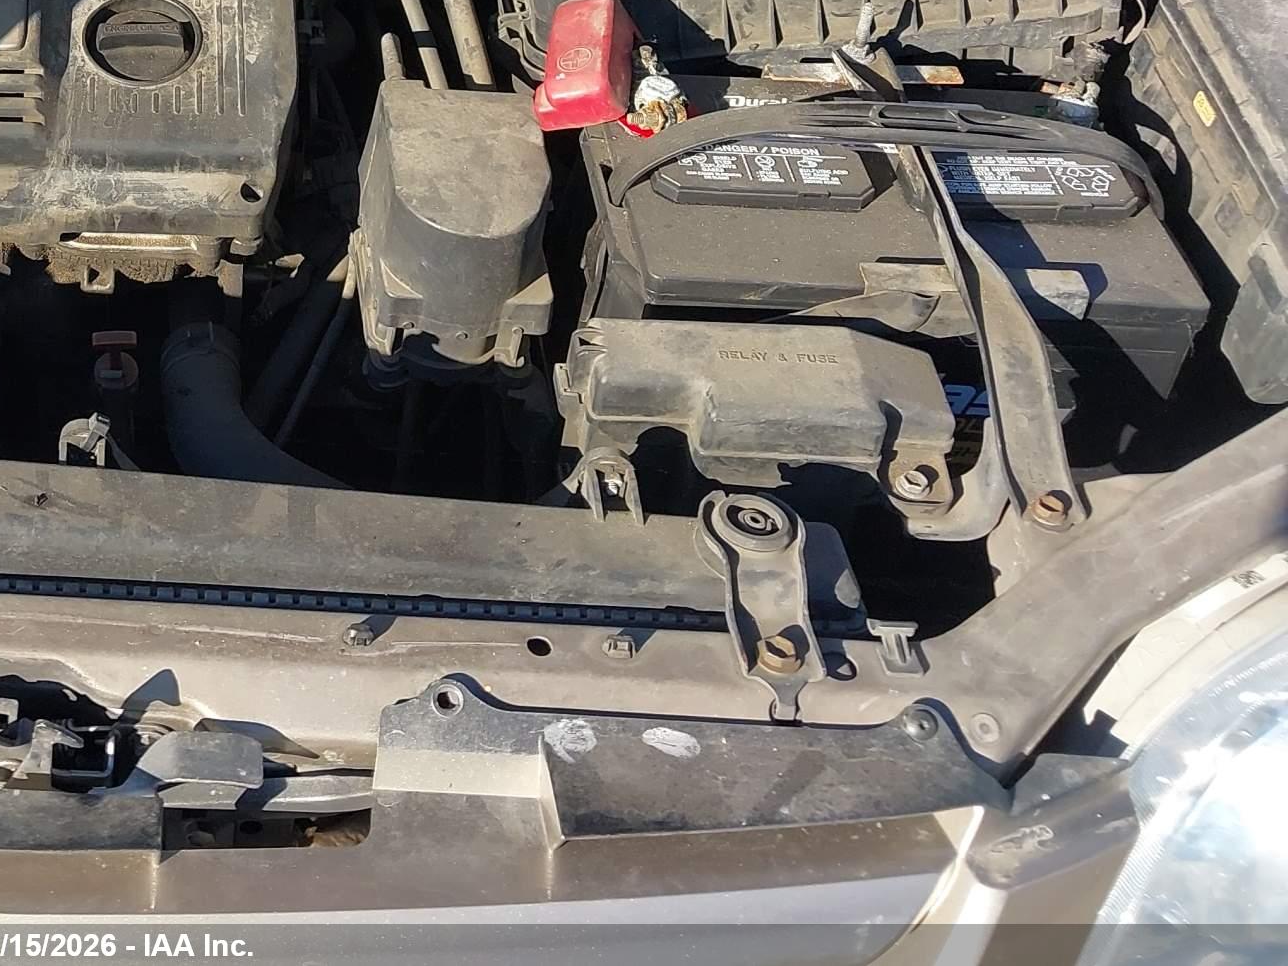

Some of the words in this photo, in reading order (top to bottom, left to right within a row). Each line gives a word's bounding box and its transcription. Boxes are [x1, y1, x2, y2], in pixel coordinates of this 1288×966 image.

[723, 95, 793, 107] Dural
[771, 146, 820, 155] POISON
[718, 349, 768, 363] RELAY
[776, 353, 788, 363] &
[796, 353, 840, 366] FUSE
